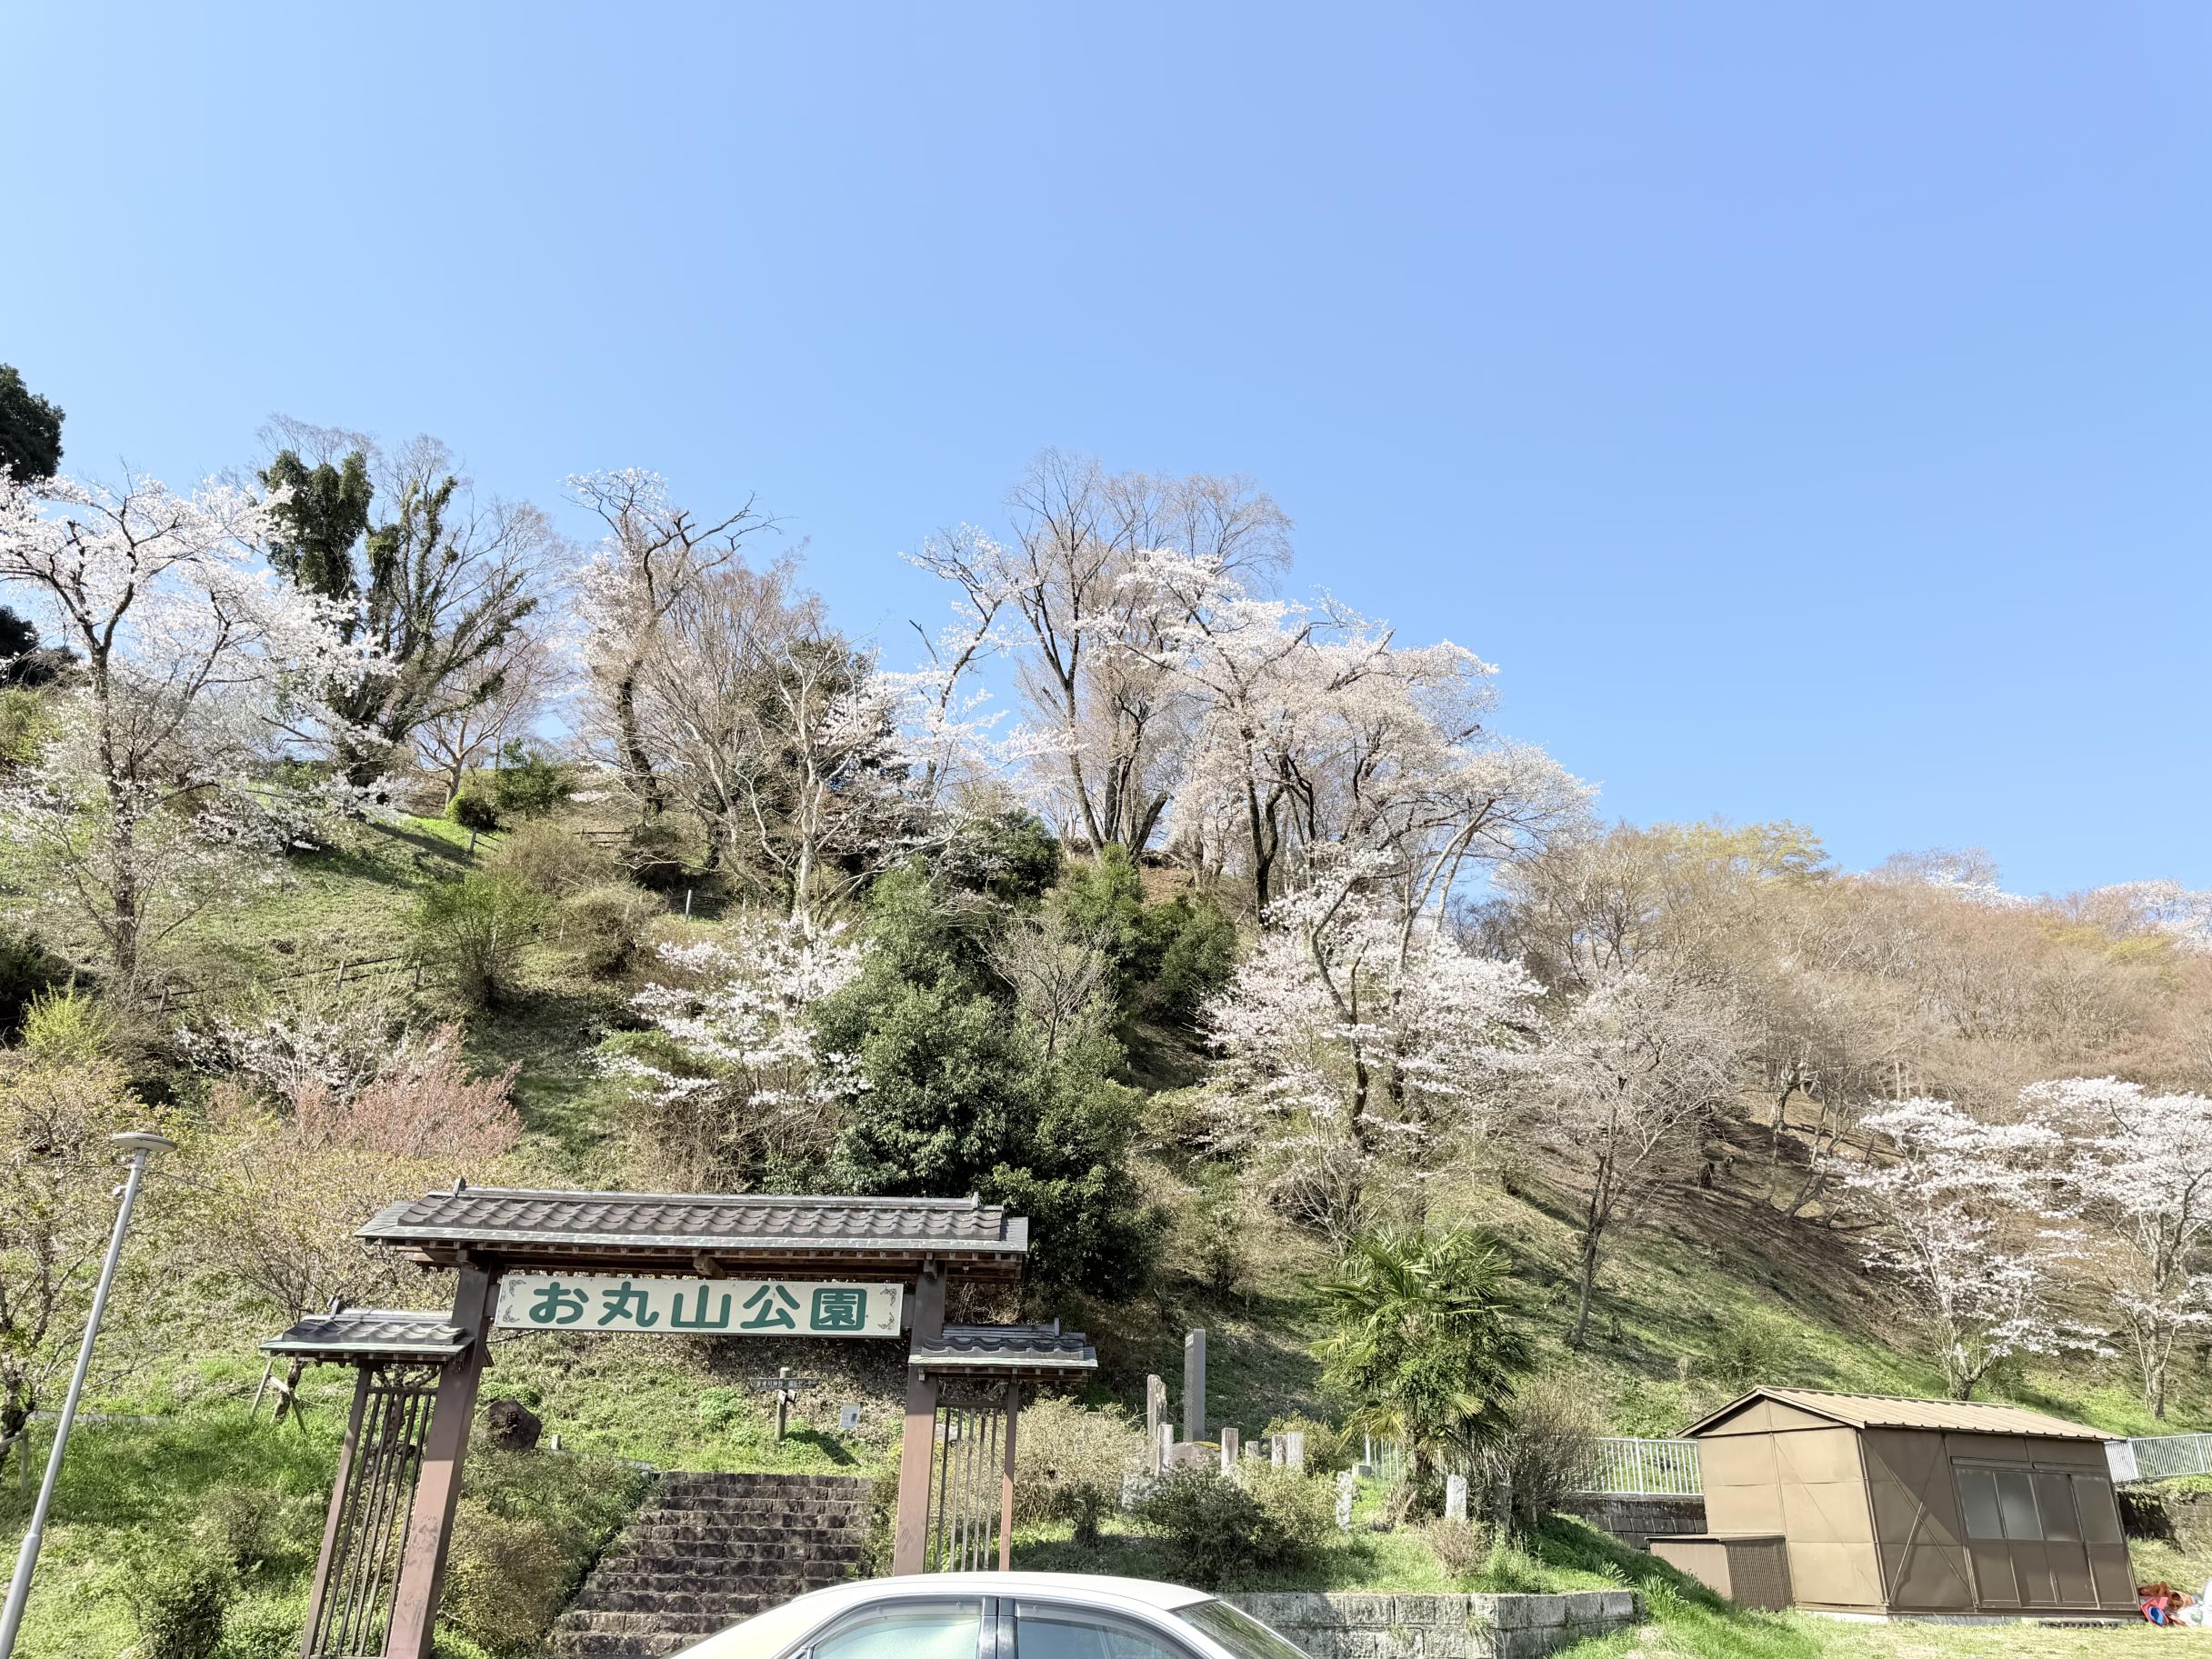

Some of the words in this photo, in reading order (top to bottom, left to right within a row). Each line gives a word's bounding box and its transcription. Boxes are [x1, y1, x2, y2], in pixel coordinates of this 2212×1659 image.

[528, 1281, 866, 1331] お丸山公園
